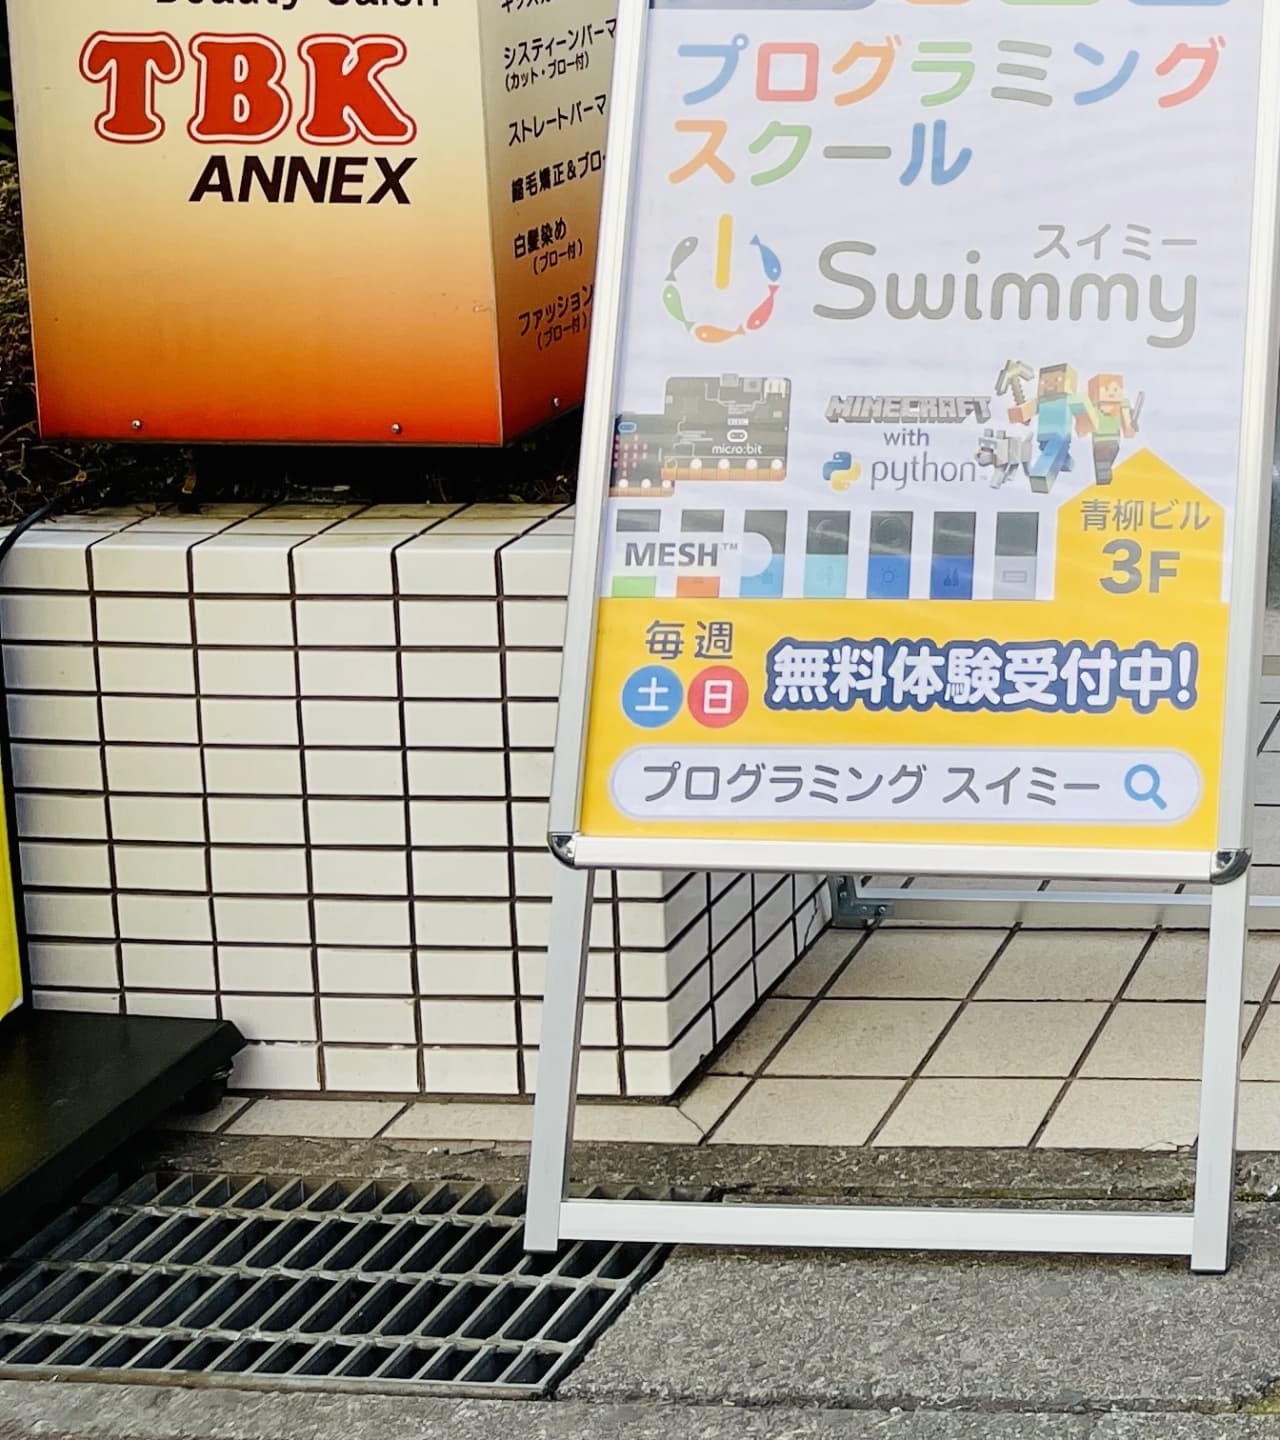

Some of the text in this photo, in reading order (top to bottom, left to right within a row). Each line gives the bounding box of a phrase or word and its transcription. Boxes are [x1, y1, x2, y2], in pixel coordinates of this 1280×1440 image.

[79, 30, 418, 146] TBK
[677, 33, 1227, 109] プログラミング
[668, 119, 973, 187] スクール
[189, 156, 418, 205] ANNEX
[511, 150, 606, 203] 縮毛矯正&ブロ
[514, 216, 567, 259] 白髪染め
[1033, 223, 1198, 262] スイミー
[518, 284, 594, 337] ファッション
[813, 240, 1198, 349] Swimmy
[825, 395, 992, 424] MINECRAFT
[711, 442, 763, 456] micro:bit
[883, 428, 930, 447] with
[870, 451, 976, 492] python
[1080, 498, 1210, 531] 青柳ビル
[1100, 539, 1181, 595] 3F
[645, 620, 734, 661] 毎週
[770, 641, 1199, 708] 無料体験受付中!
[636, 679, 733, 716] 土 日
[642, 763, 1100, 807] プログラミング スイミー
